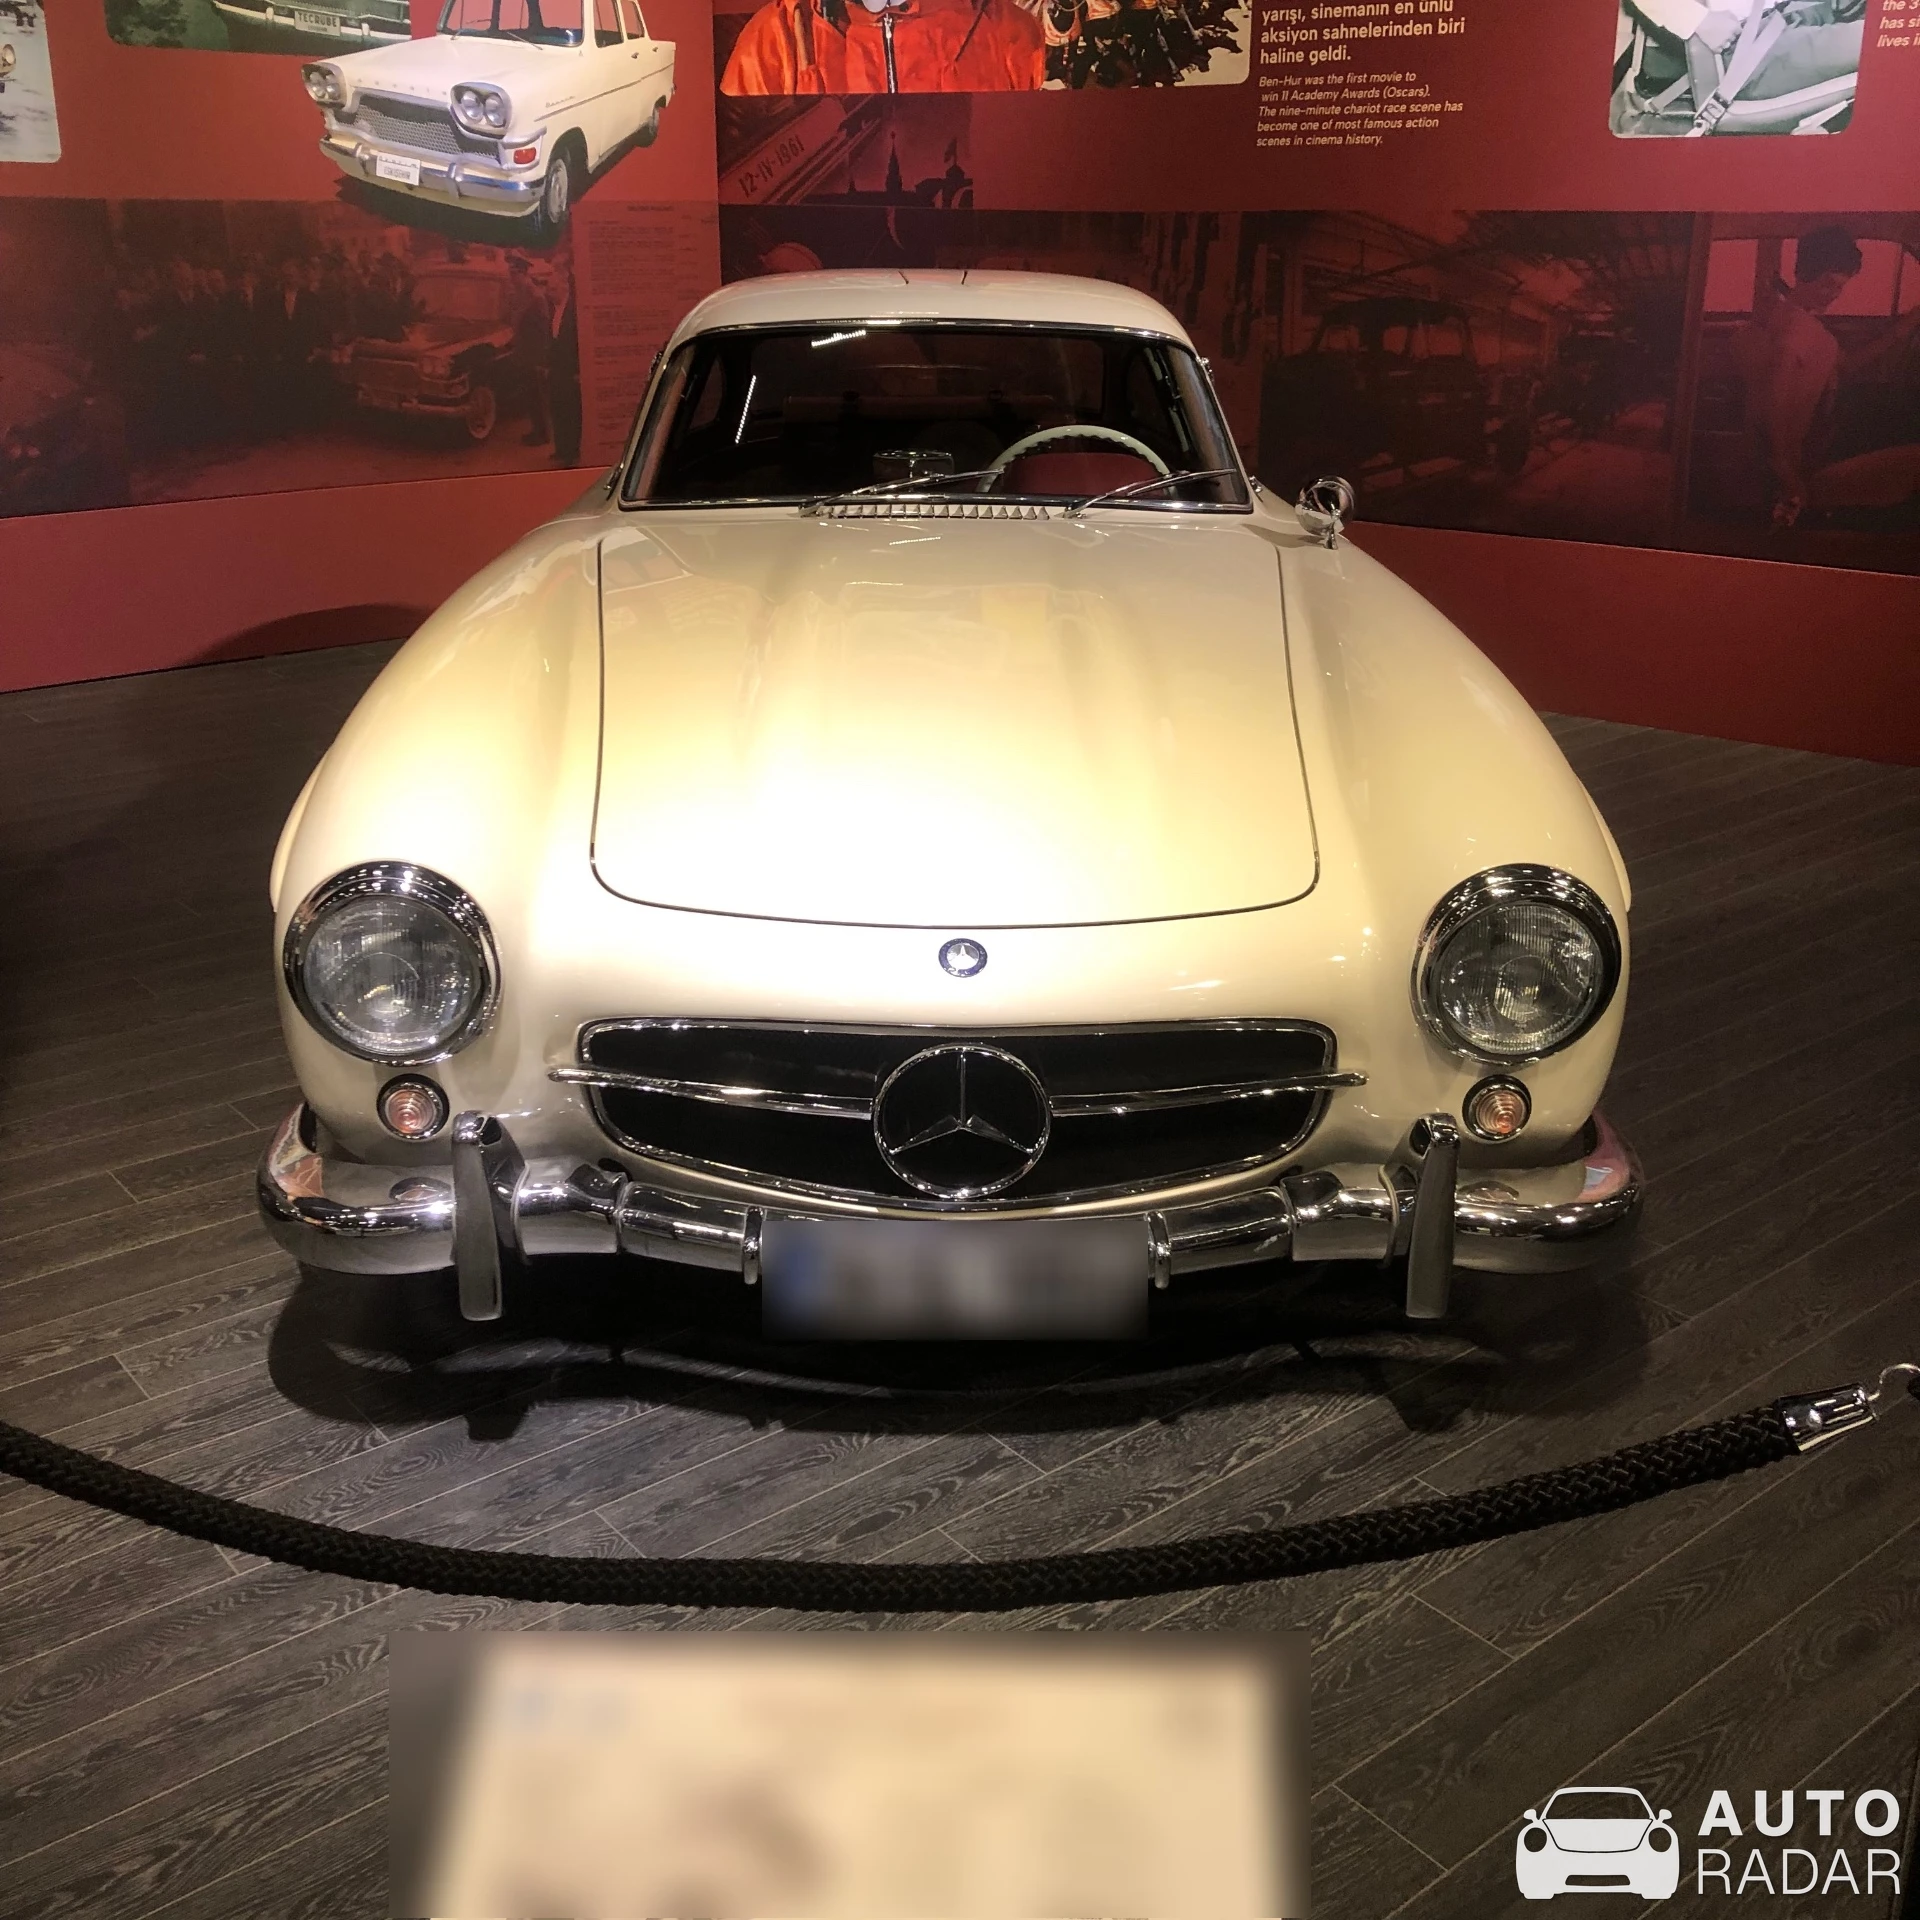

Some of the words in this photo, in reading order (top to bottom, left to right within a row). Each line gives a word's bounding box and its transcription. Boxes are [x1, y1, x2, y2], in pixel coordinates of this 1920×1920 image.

[1882, 0, 1907, 11] the
[1262, 8, 1306, 26] yarışı,
[1311, 2, 1390, 20] sinemanın
[1394, 2, 1414, 15] en
[1260, 26, 1318, 46] aksiyon
[1322, 20, 1433, 40] sahnelerinden
[1437, 16, 1466, 35] biri
[1879, 16, 1905, 30] has
[1876, 34, 1911, 48] lives
[1260, 47, 1305, 65] haline
[1309, 44, 1352, 66] geldi.
[1259, 74, 1302, 87] Ben-Hur
[1304, 76, 1325, 86] was
[1327, 73, 1345, 85] the
[1346, 72, 1368, 84] first
[1369, 71, 1403, 83] movie
[1405, 71, 1417, 82] to
[1261, 91, 1279, 102] win
[1290, 89, 1339, 102] Academy
[1341, 87, 1380, 100] Awards
[1382, 84, 1431, 99] (Oscars).
[1259, 106, 1277, 117] The
[1278, 104, 1342, 116] nine-minute
[1343, 102, 1381, 114] chariot
[1383, 103, 1407, 113] race
[1409, 102, 1442, 113] scene
[1443, 100, 1464, 112] has
[1257, 121, 1298, 132] become
[1299, 121, 1320, 131] one
[1321, 118, 1334, 130] of
[1334, 118, 1362, 130] most
[1363, 117, 1403, 129] famous
[1405, 116, 1440, 128] action
[1256, 137, 1292, 147] scenes
[1293, 134, 1304, 145] in
[1305, 134, 1344, 145] cinema
[1345, 133, 1384, 146] history.
